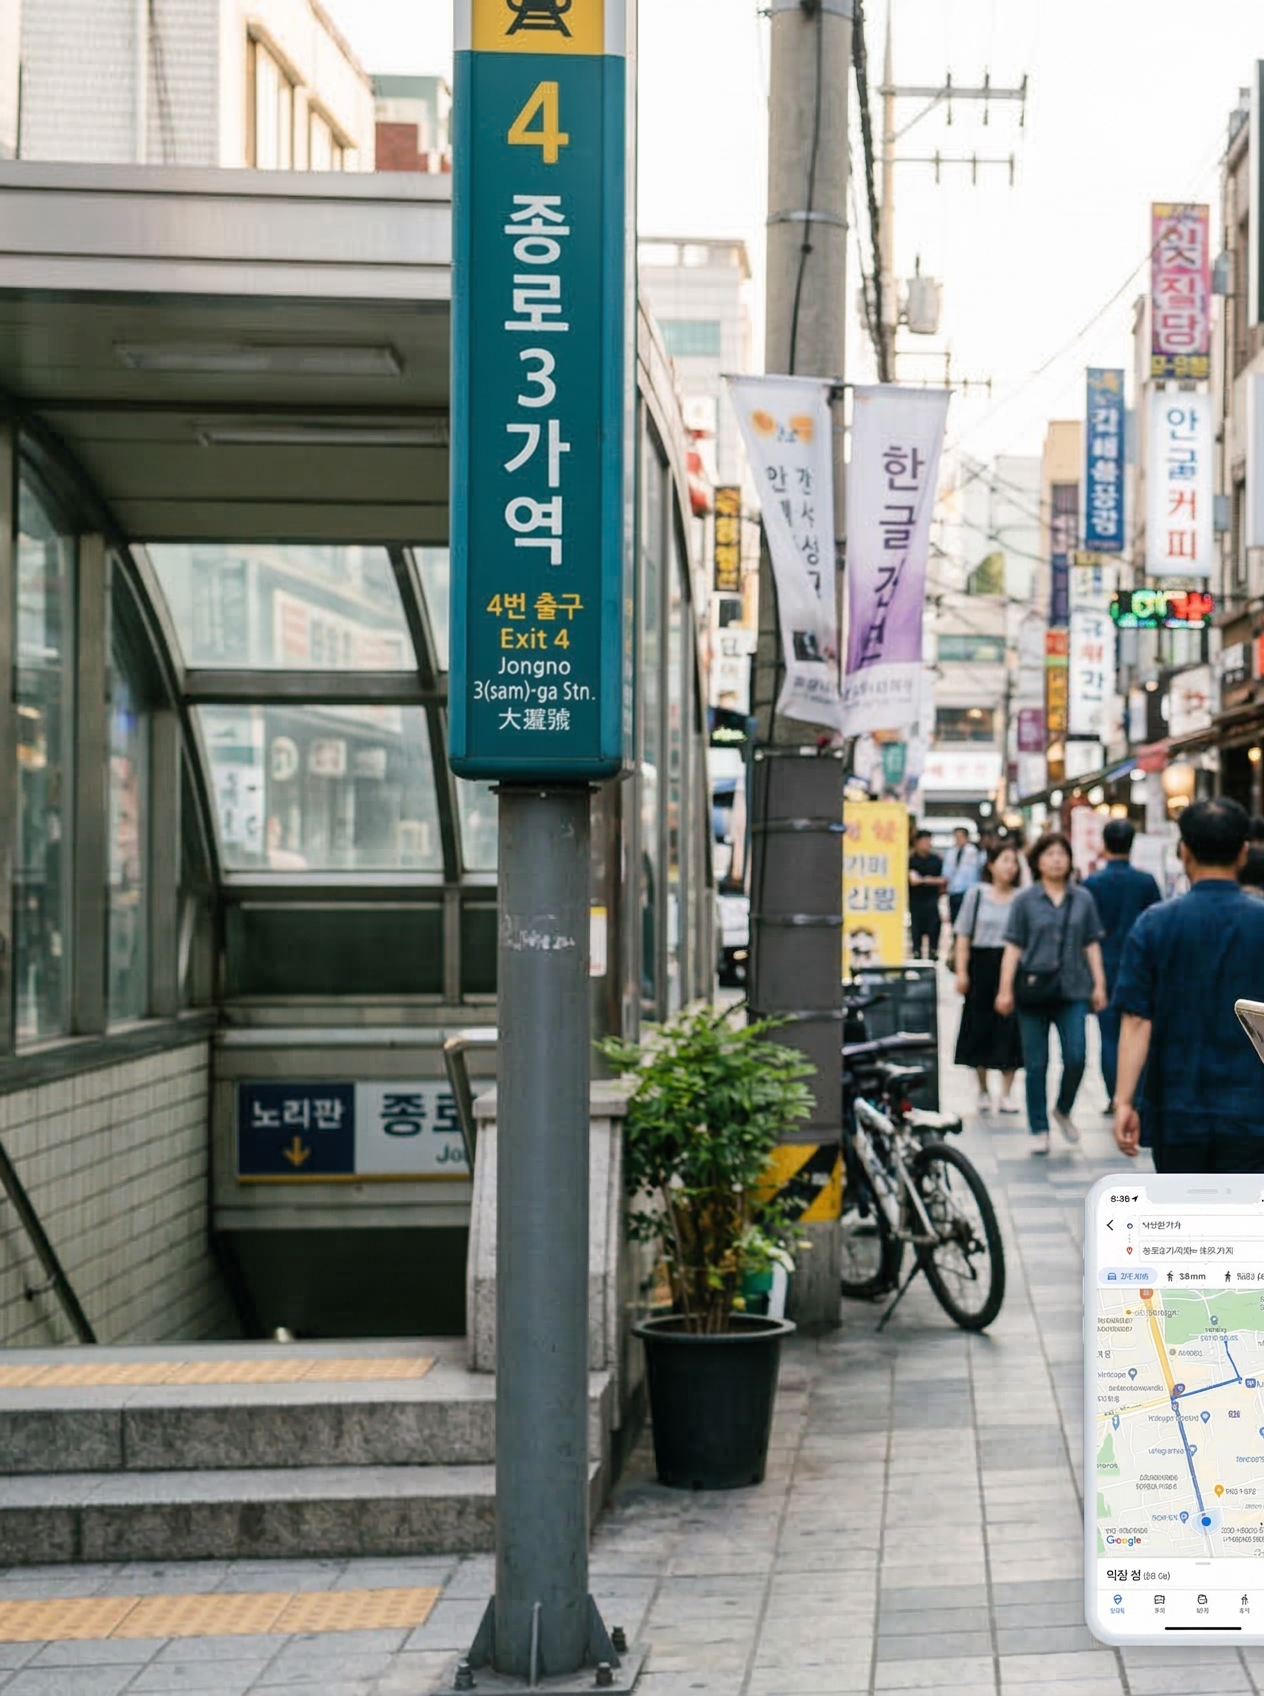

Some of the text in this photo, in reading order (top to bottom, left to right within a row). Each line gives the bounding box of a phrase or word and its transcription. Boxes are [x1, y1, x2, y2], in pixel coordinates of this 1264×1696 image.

[507, 81, 570, 164] 4
[487, 592, 584, 620] 4번 출구
[500, 628, 570, 649] Exit 4
[498, 656, 571, 678] Jongno
[473, 681, 596, 703] 3(sam)-ga Stn.
[251, 1097, 344, 1131] 노리판
[436, 1144, 470, 1164] Jo
[1106, 1535, 1142, 1547] Google
